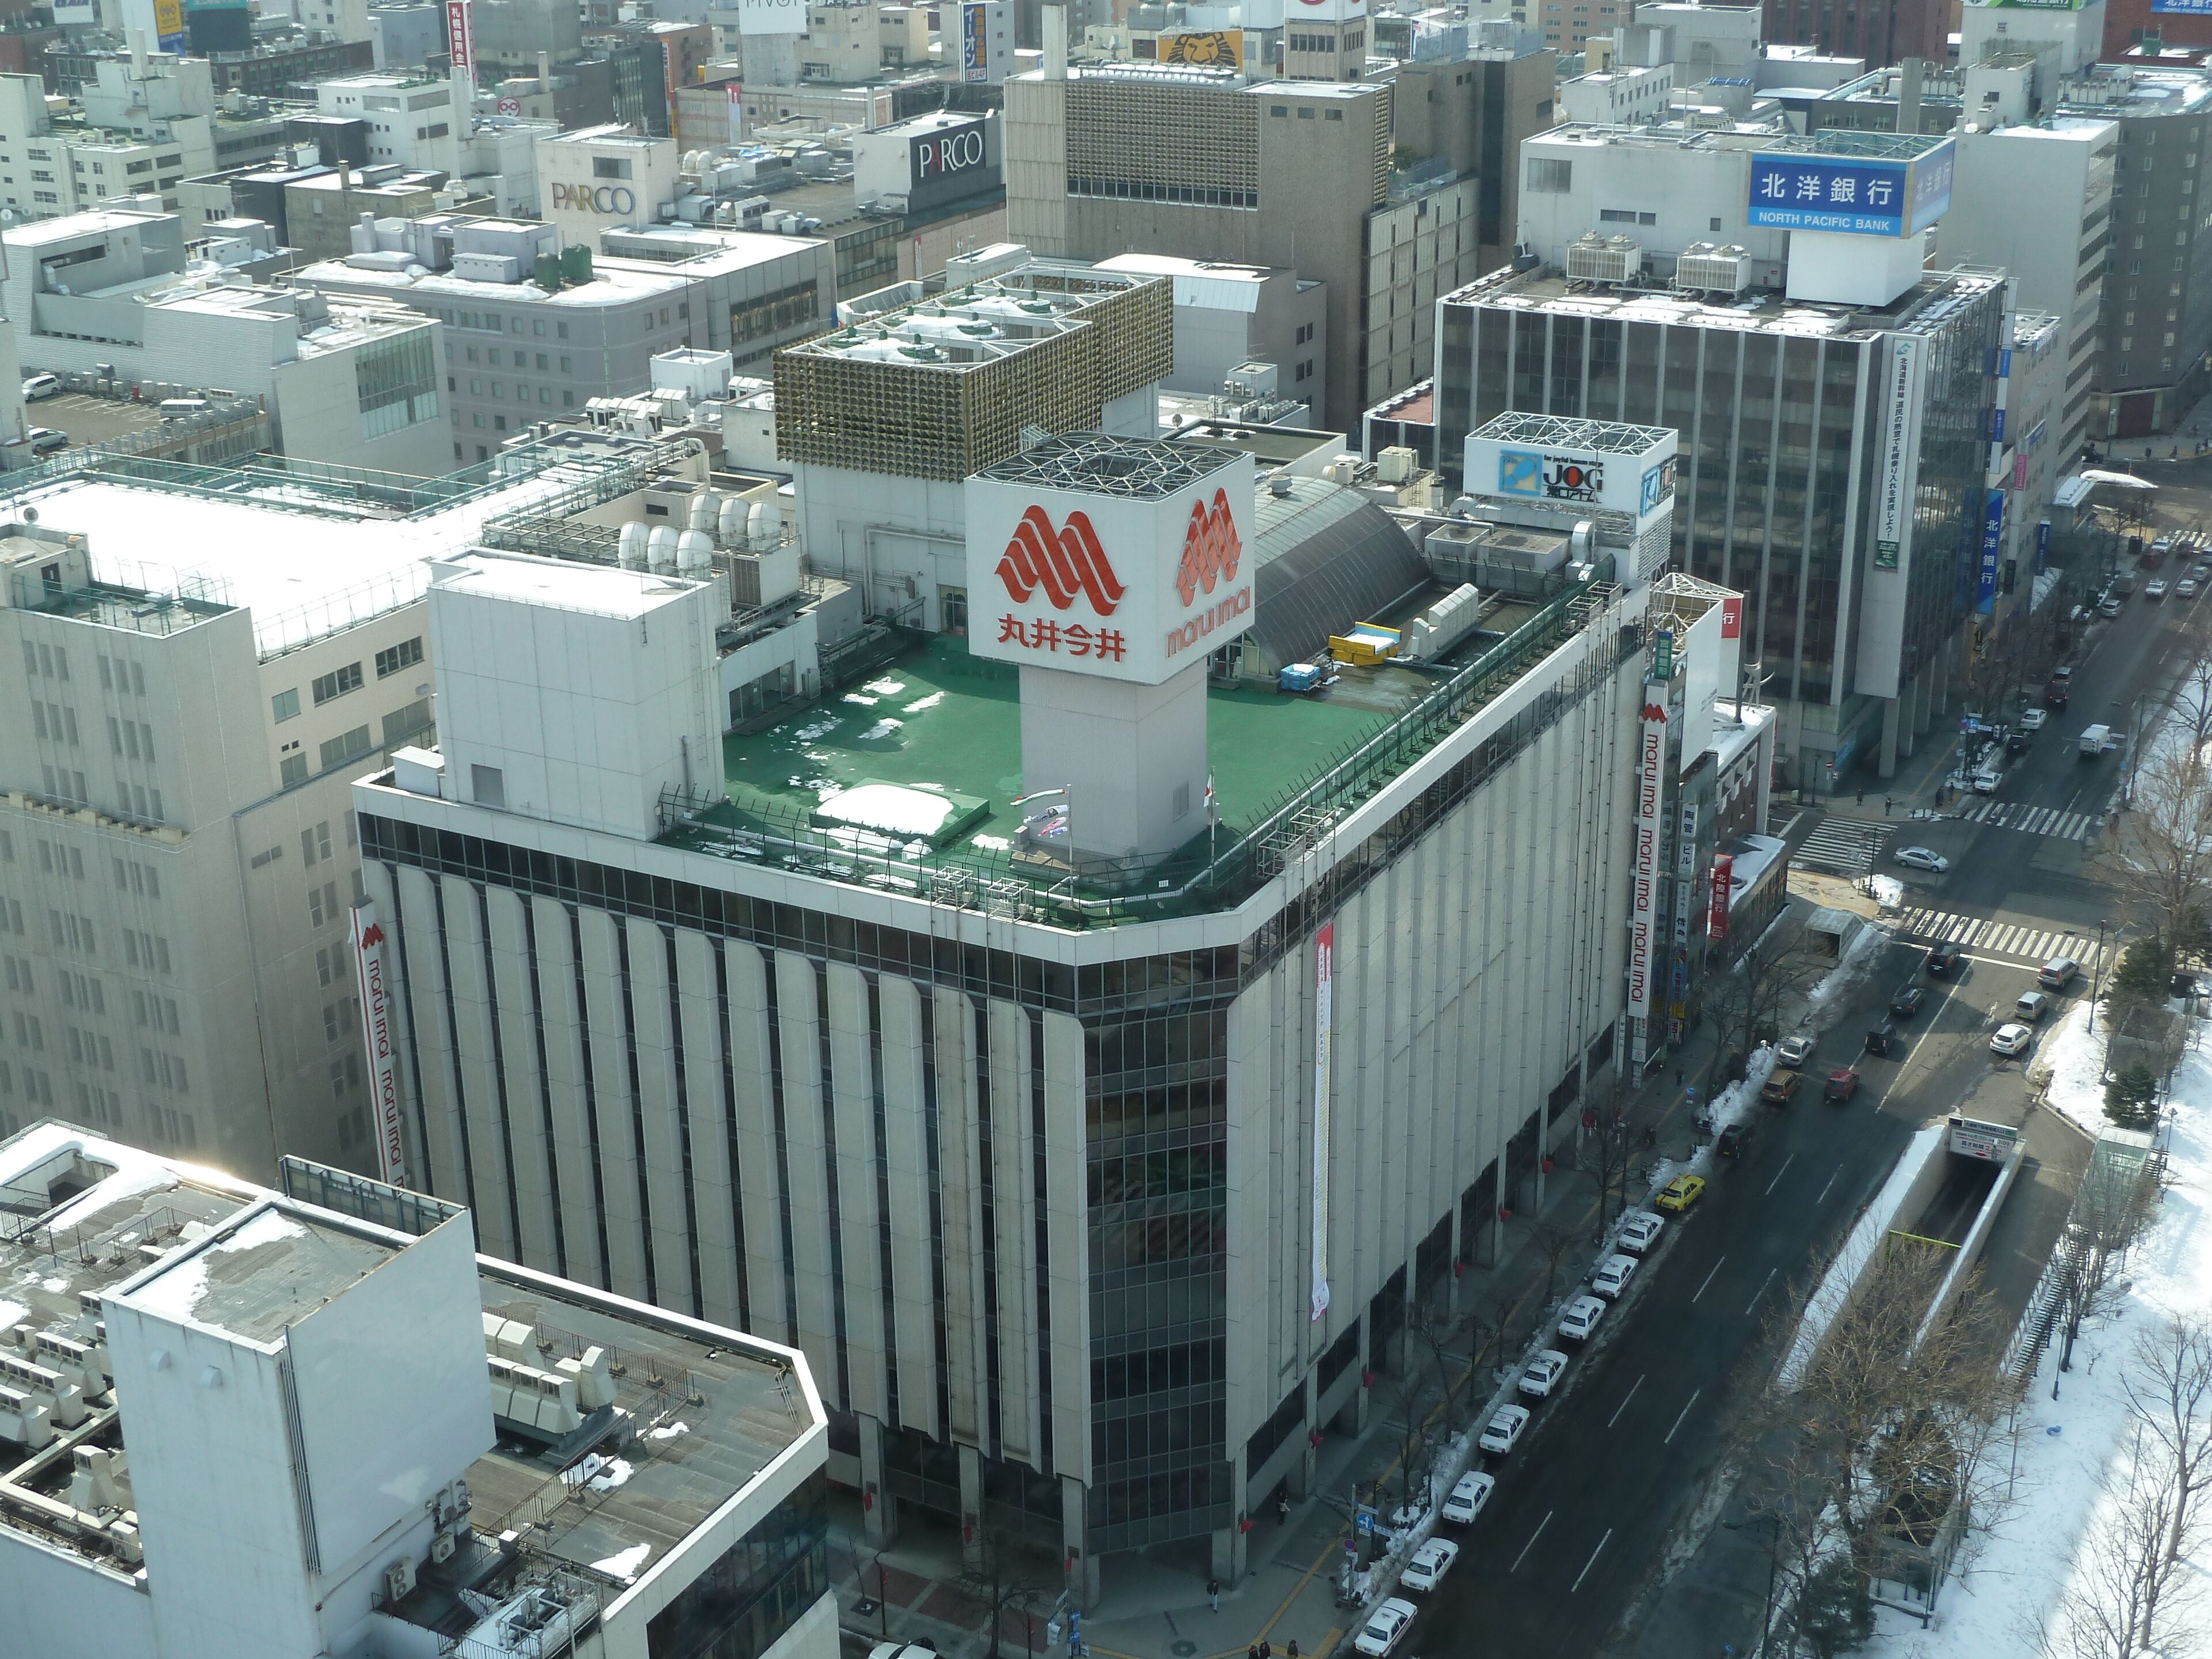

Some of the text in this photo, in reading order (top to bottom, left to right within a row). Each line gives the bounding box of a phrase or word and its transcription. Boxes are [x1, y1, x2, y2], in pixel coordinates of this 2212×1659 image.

[965, 7, 975, 67] イーオン
[919, 131, 982, 177] PARCO
[551, 183, 635, 215] PARCO
[1761, 173, 1892, 205] 北洋銀行
[1759, 212, 1889, 231] NORTH PACIFIC BANK
[1543, 464, 1603, 493] JOG
[1980, 520, 1998, 584] 北洋銀行
[997, 612, 1126, 662] 丸井今井
[1166, 608, 1215, 658] marui
[1722, 612, 1735, 624] 行
[1645, 733, 1658, 782] marui
[1639, 829, 1653, 876] marui
[1715, 873, 1726, 913] 北陸銀行
[1634, 922, 1647, 968] marui
[369, 959, 384, 1015] marui
[381, 1069, 396, 1125] marui
